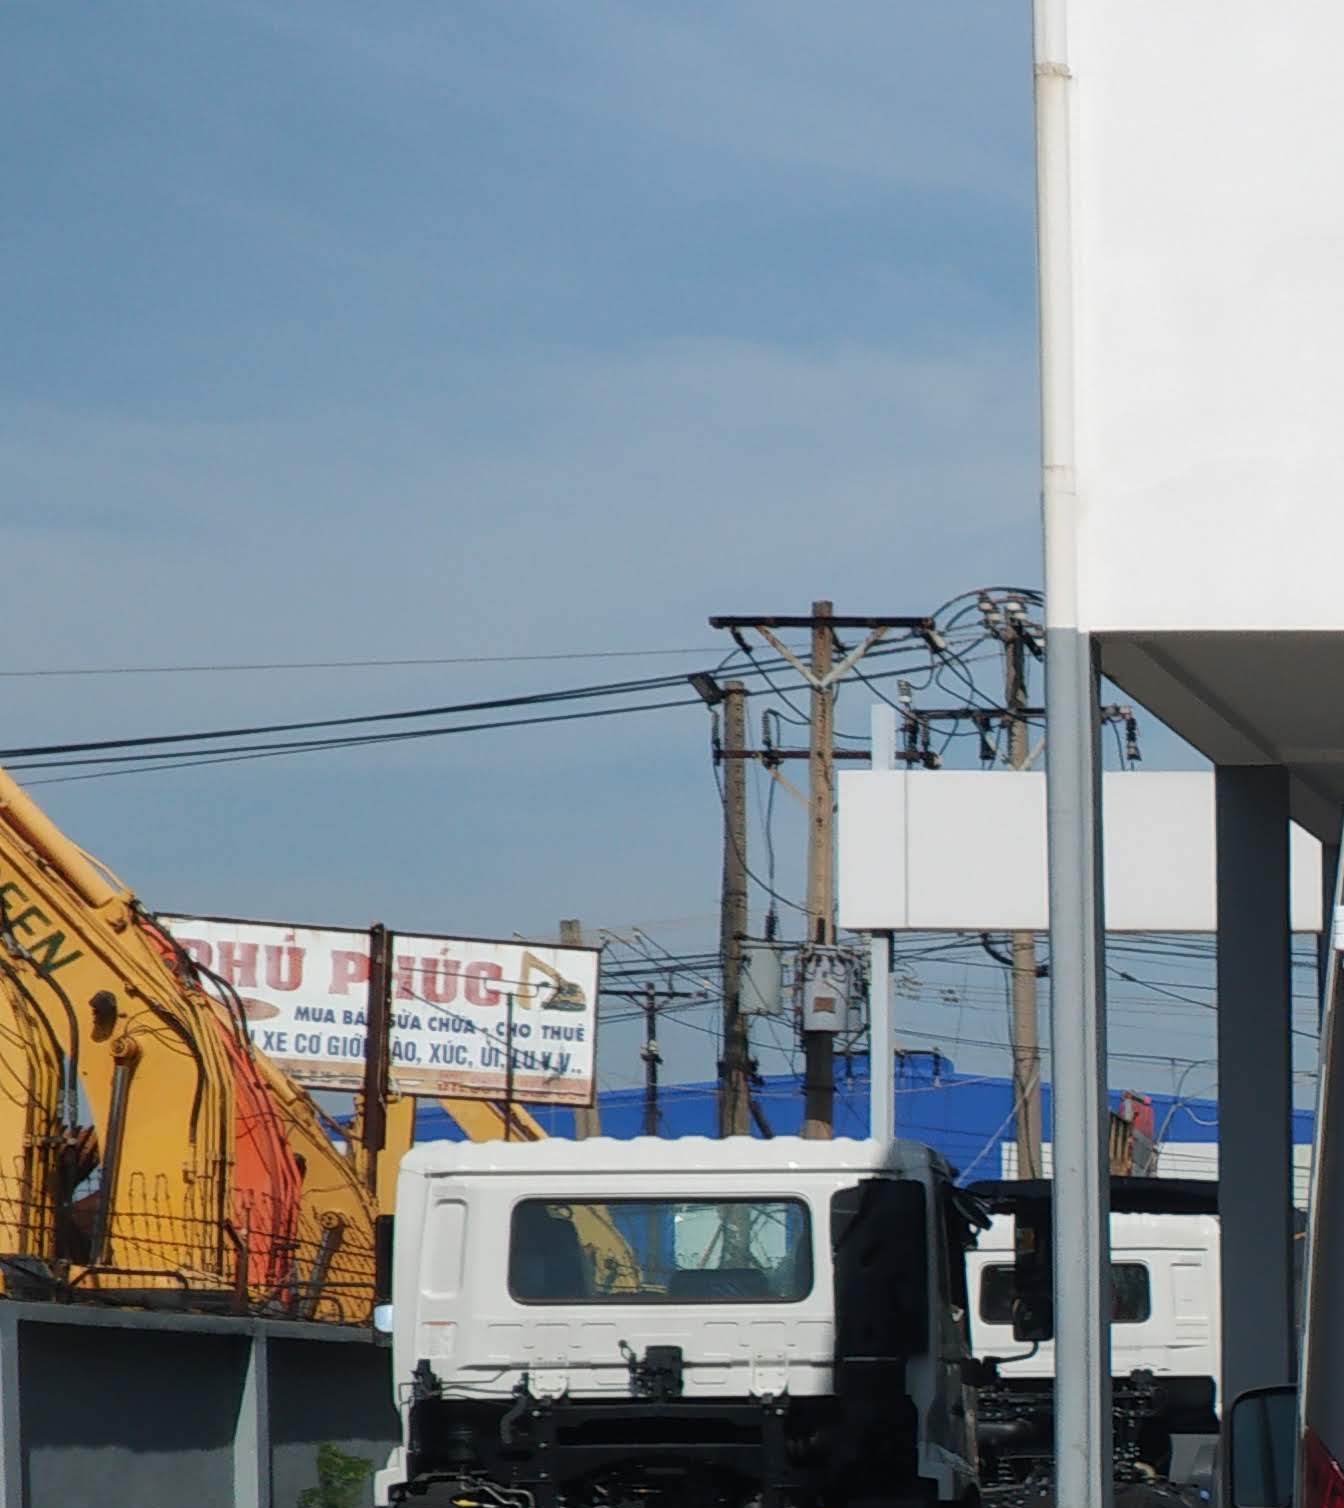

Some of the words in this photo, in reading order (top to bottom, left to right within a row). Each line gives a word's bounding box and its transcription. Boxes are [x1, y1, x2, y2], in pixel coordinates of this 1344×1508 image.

[294, 1005, 336, 1024] MUA
[343, 1004, 368, 1026] BÁ
[496, 1021, 532, 1039] CHO
[263, 1030, 288, 1052] XE
[295, 1031, 322, 1054] CƠ
[391, 1036, 422, 1065] ÀO,
